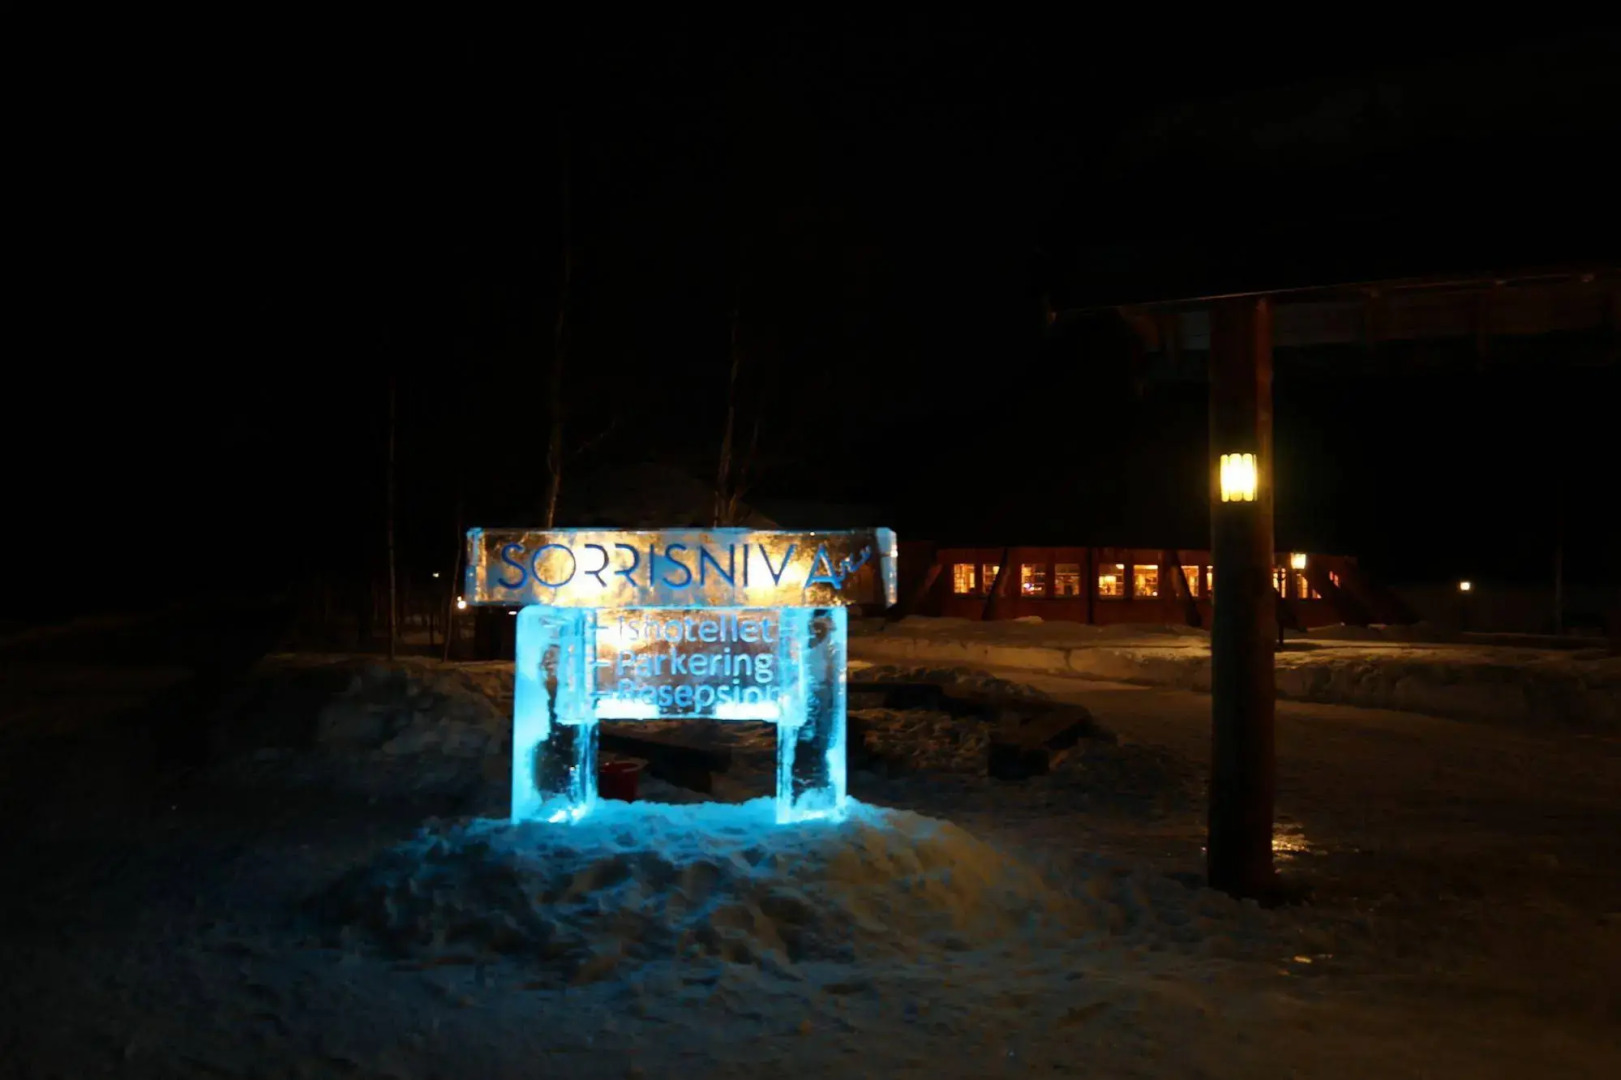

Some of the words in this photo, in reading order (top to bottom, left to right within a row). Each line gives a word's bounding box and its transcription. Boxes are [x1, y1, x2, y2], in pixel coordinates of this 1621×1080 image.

[497, 542, 845, 590] SORRISNIVA
[618, 615, 776, 643] Ishotellet
[616, 647, 774, 683] Parkering
